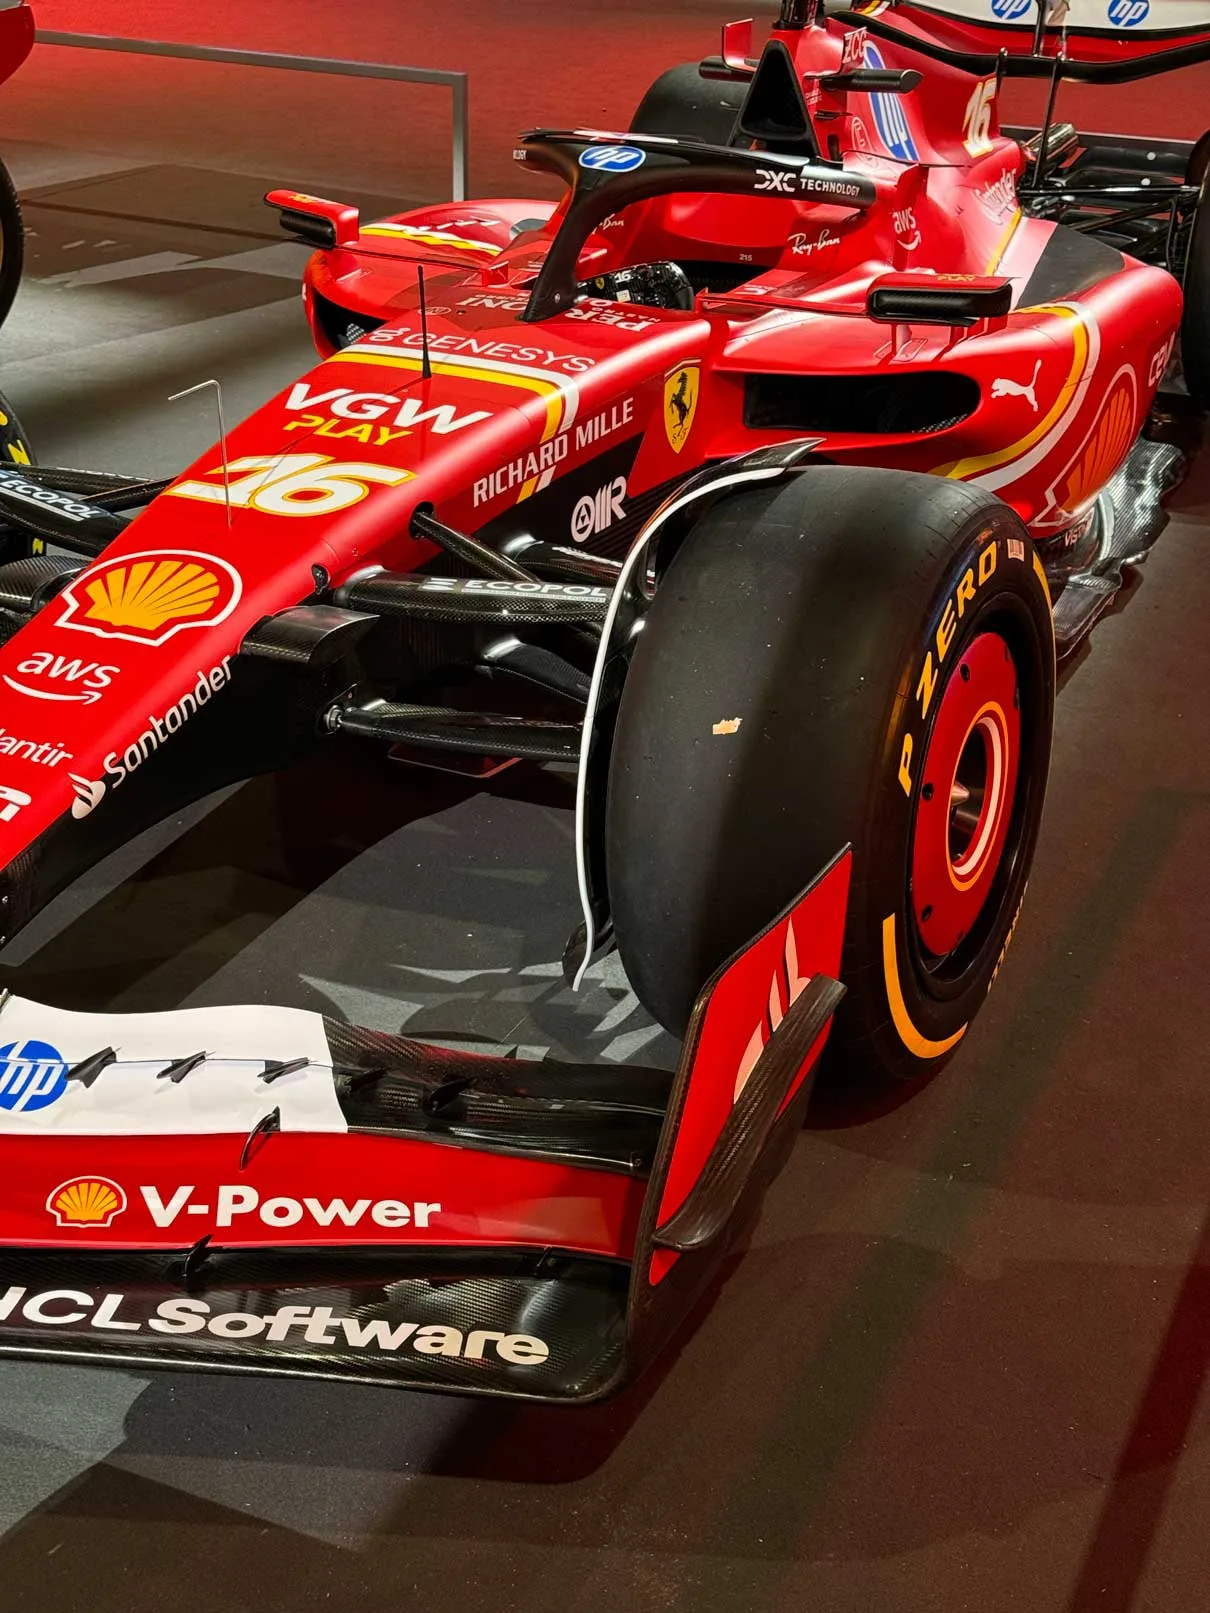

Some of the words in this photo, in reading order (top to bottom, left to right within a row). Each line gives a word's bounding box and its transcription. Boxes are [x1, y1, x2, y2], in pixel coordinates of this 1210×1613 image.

[1109, 0, 1149, 27] hp
[962, 77, 997, 159] 16
[754, 169, 797, 192] DXC
[800, 178, 860, 197] TECHNOLOGY
[892, 207, 917, 234] aws
[787, 228, 841, 256] Ray-Ban
[402, 333, 597, 371] GENESYS
[285, 383, 494, 434] VGW
[283, 414, 413, 446] PLAY
[473, 433, 569, 508] RICHARD
[575, 397, 634, 451] MILLE
[1, 480, 101, 519] ECOPOL
[163, 453, 418, 517] 16
[464, 580, 608, 597] ECOPOL
[16, 651, 121, 688] aws
[898, 733, 913, 797] P
[916, 541, 997, 719] ZERO
[102, 655, 231, 788] Santander
[139, 1185, 442, 1228] V-Power
